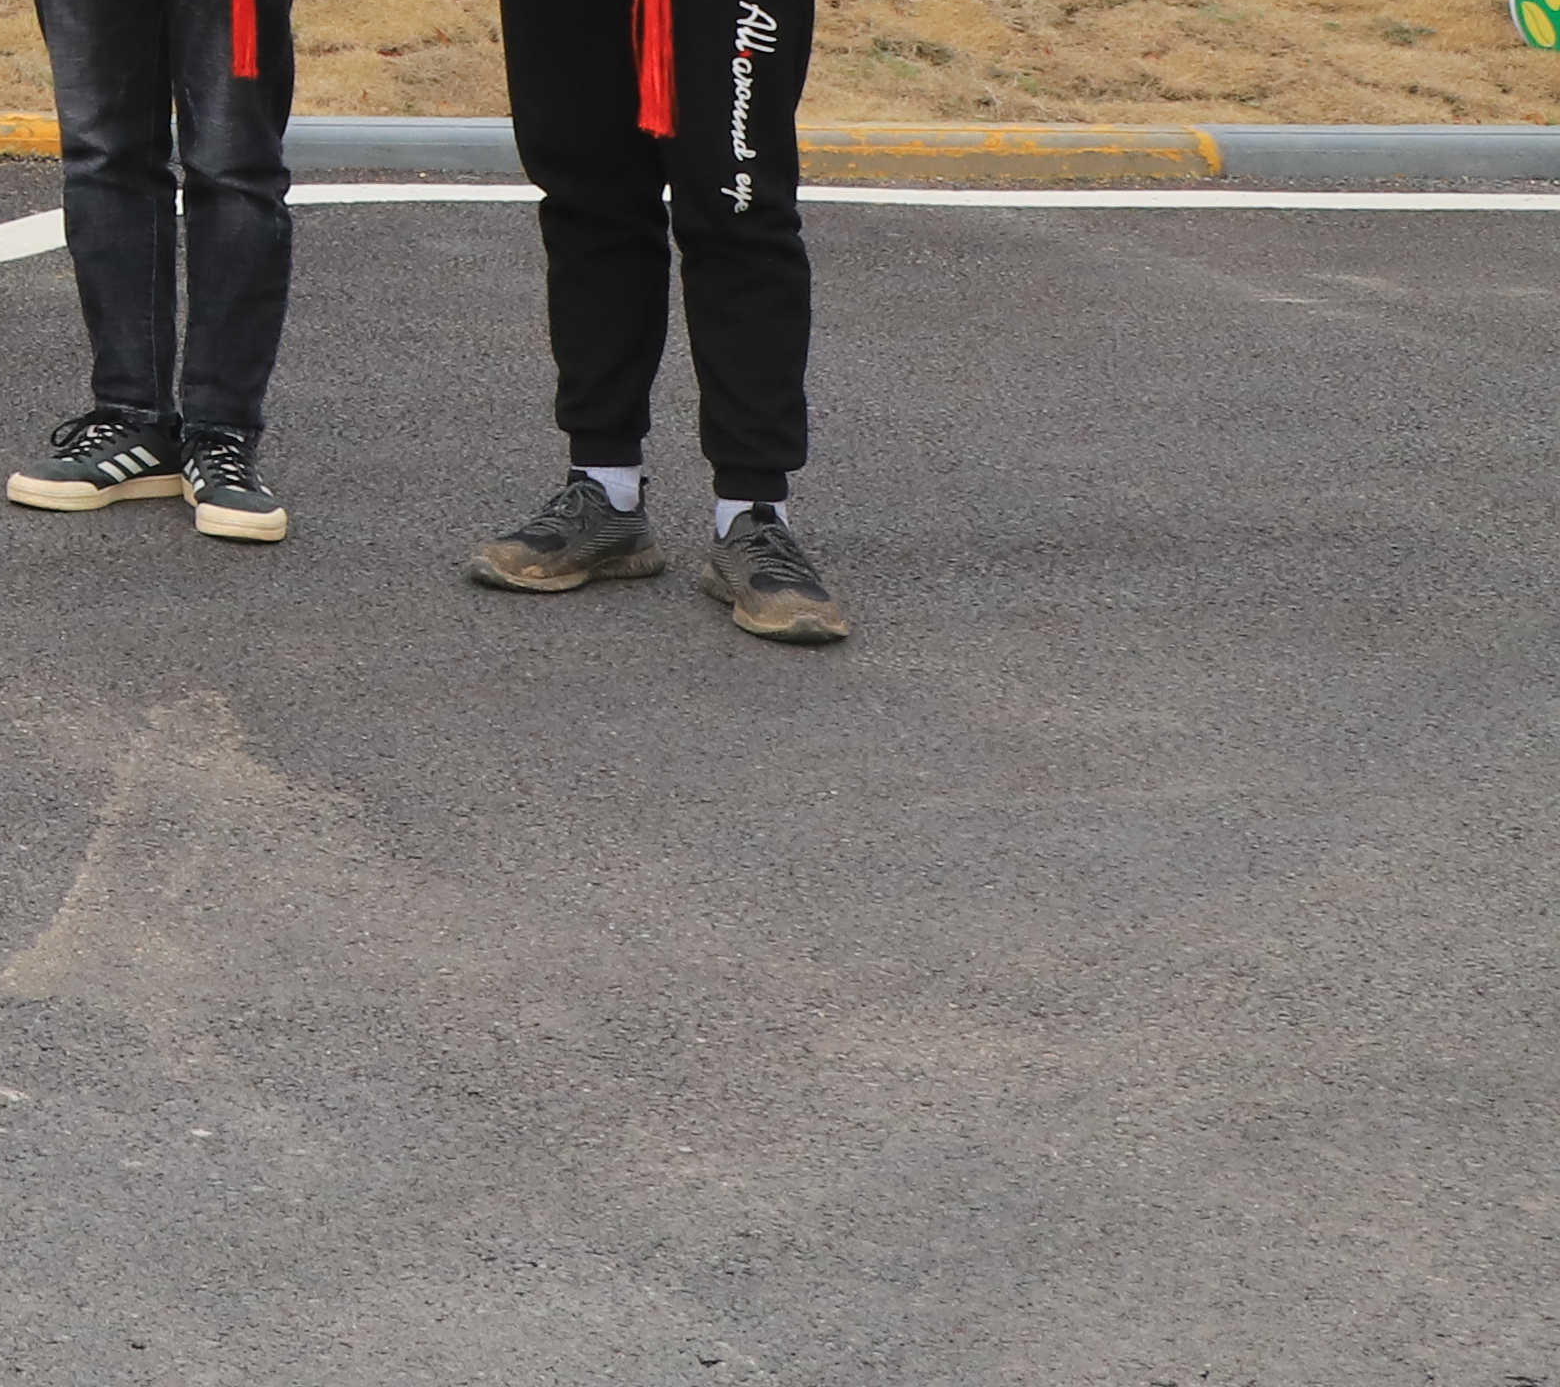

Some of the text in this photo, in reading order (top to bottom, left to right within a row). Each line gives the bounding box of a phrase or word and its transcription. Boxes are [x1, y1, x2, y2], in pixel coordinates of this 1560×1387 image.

[721, 0, 776, 214] All around eye
